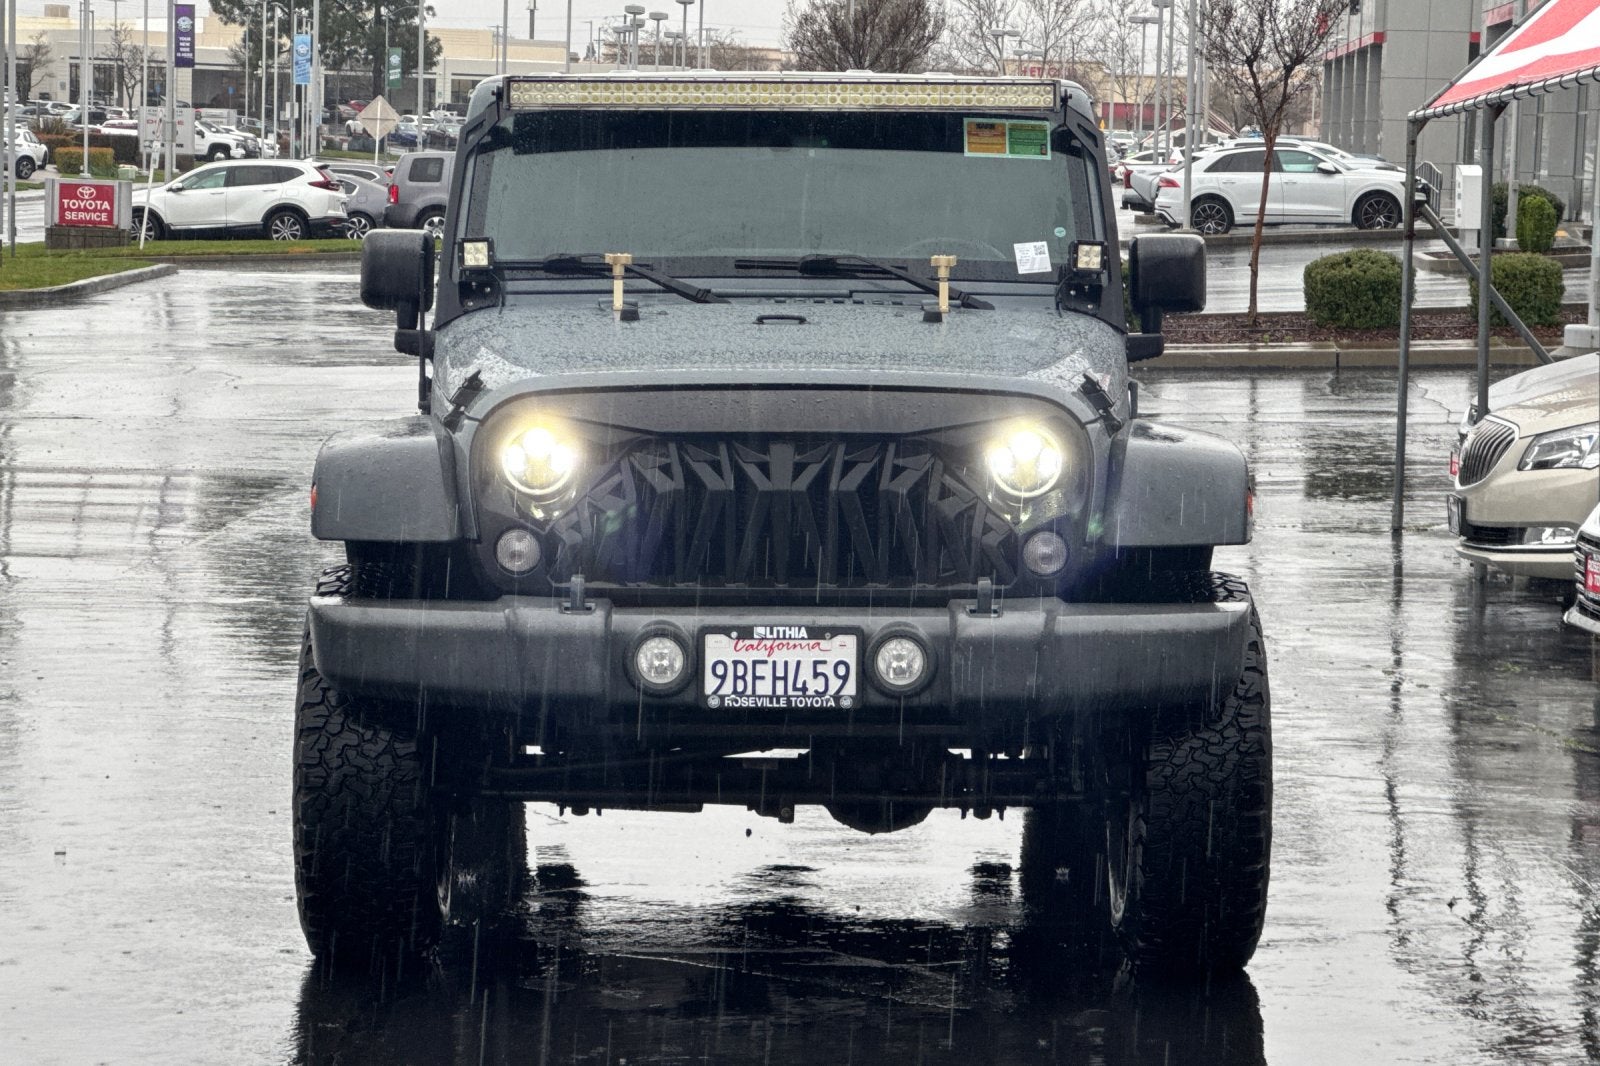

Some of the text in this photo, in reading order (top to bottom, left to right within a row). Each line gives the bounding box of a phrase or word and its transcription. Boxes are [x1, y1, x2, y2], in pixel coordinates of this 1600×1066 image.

[62, 199, 111, 210] TOYOTA
[64, 211, 108, 221] SERVICE
[766, 626, 808, 639] LITHIA
[733, 639, 832, 657] California
[711, 659, 851, 696] 9BFH459
[724, 696, 836, 708] ROSEVILLE TOYOTA
